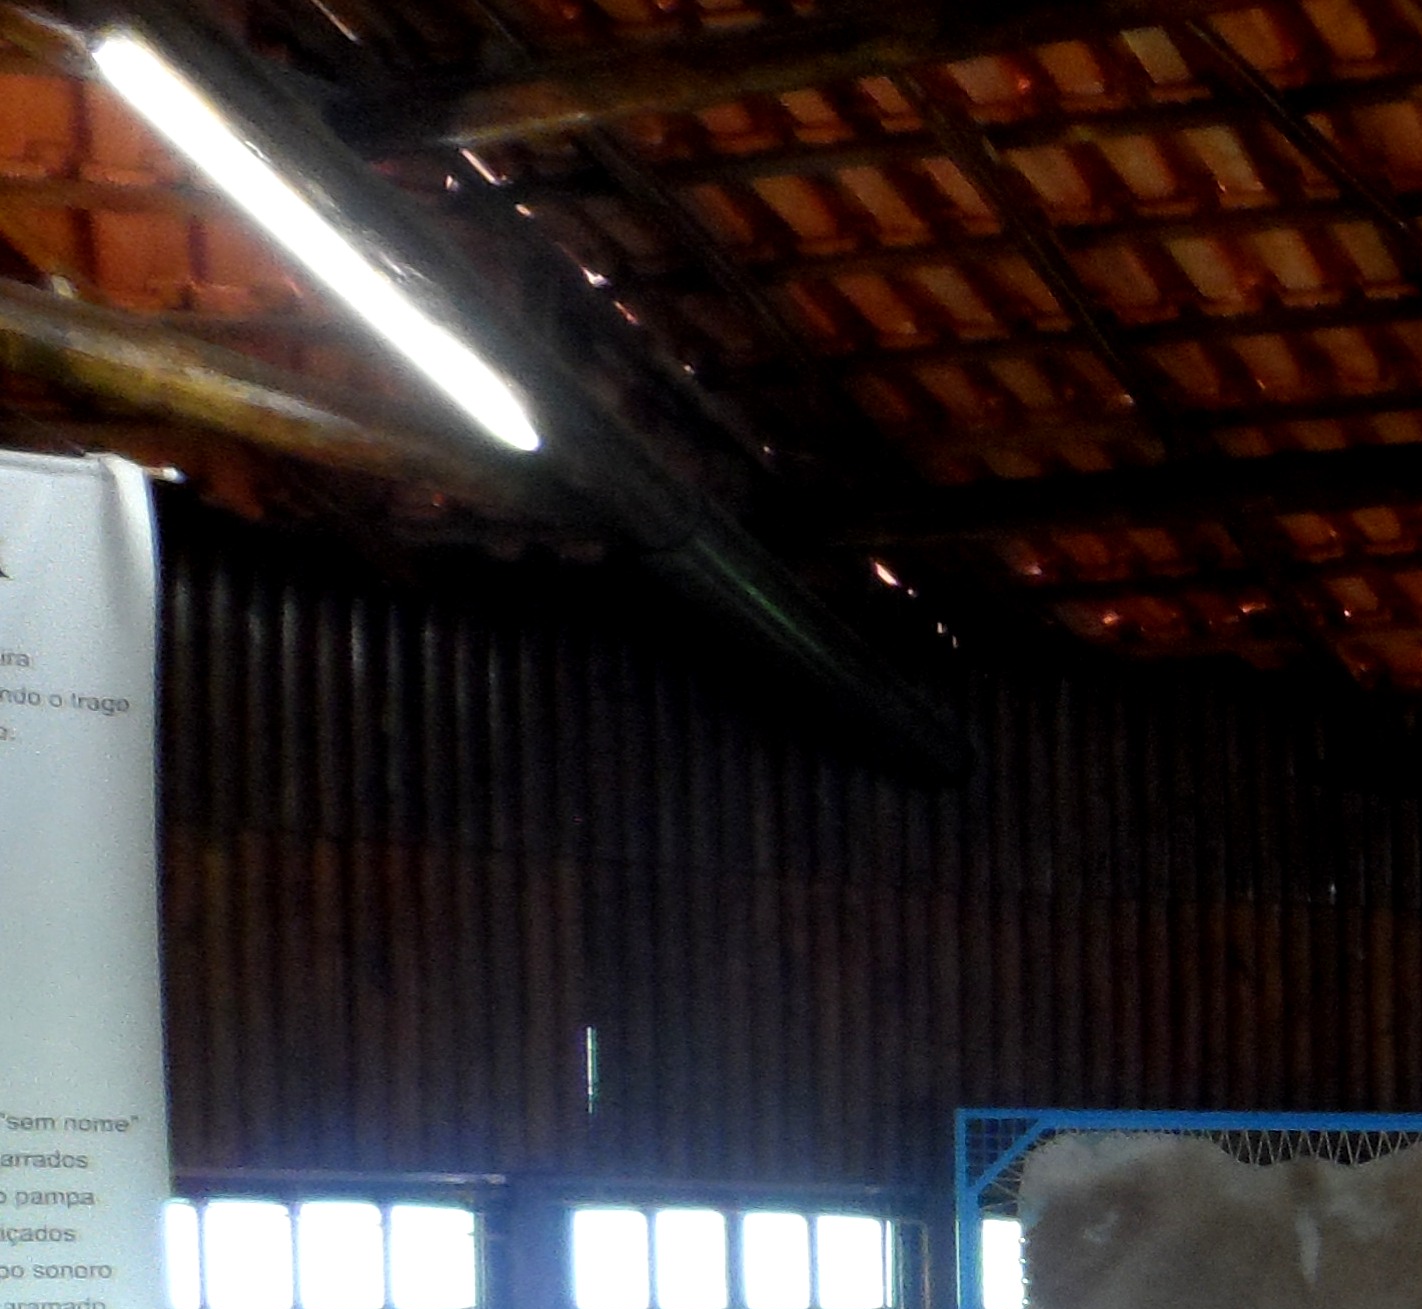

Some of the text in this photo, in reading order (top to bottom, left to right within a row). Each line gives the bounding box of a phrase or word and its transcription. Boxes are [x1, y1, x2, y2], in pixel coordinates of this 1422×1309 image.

[50, 694, 63, 708] o
[71, 692, 131, 717] trago
[64, 1114, 140, 1133] nome"
[15, 1190, 96, 1210] pampa
[33, 1264, 113, 1280] sonoro
